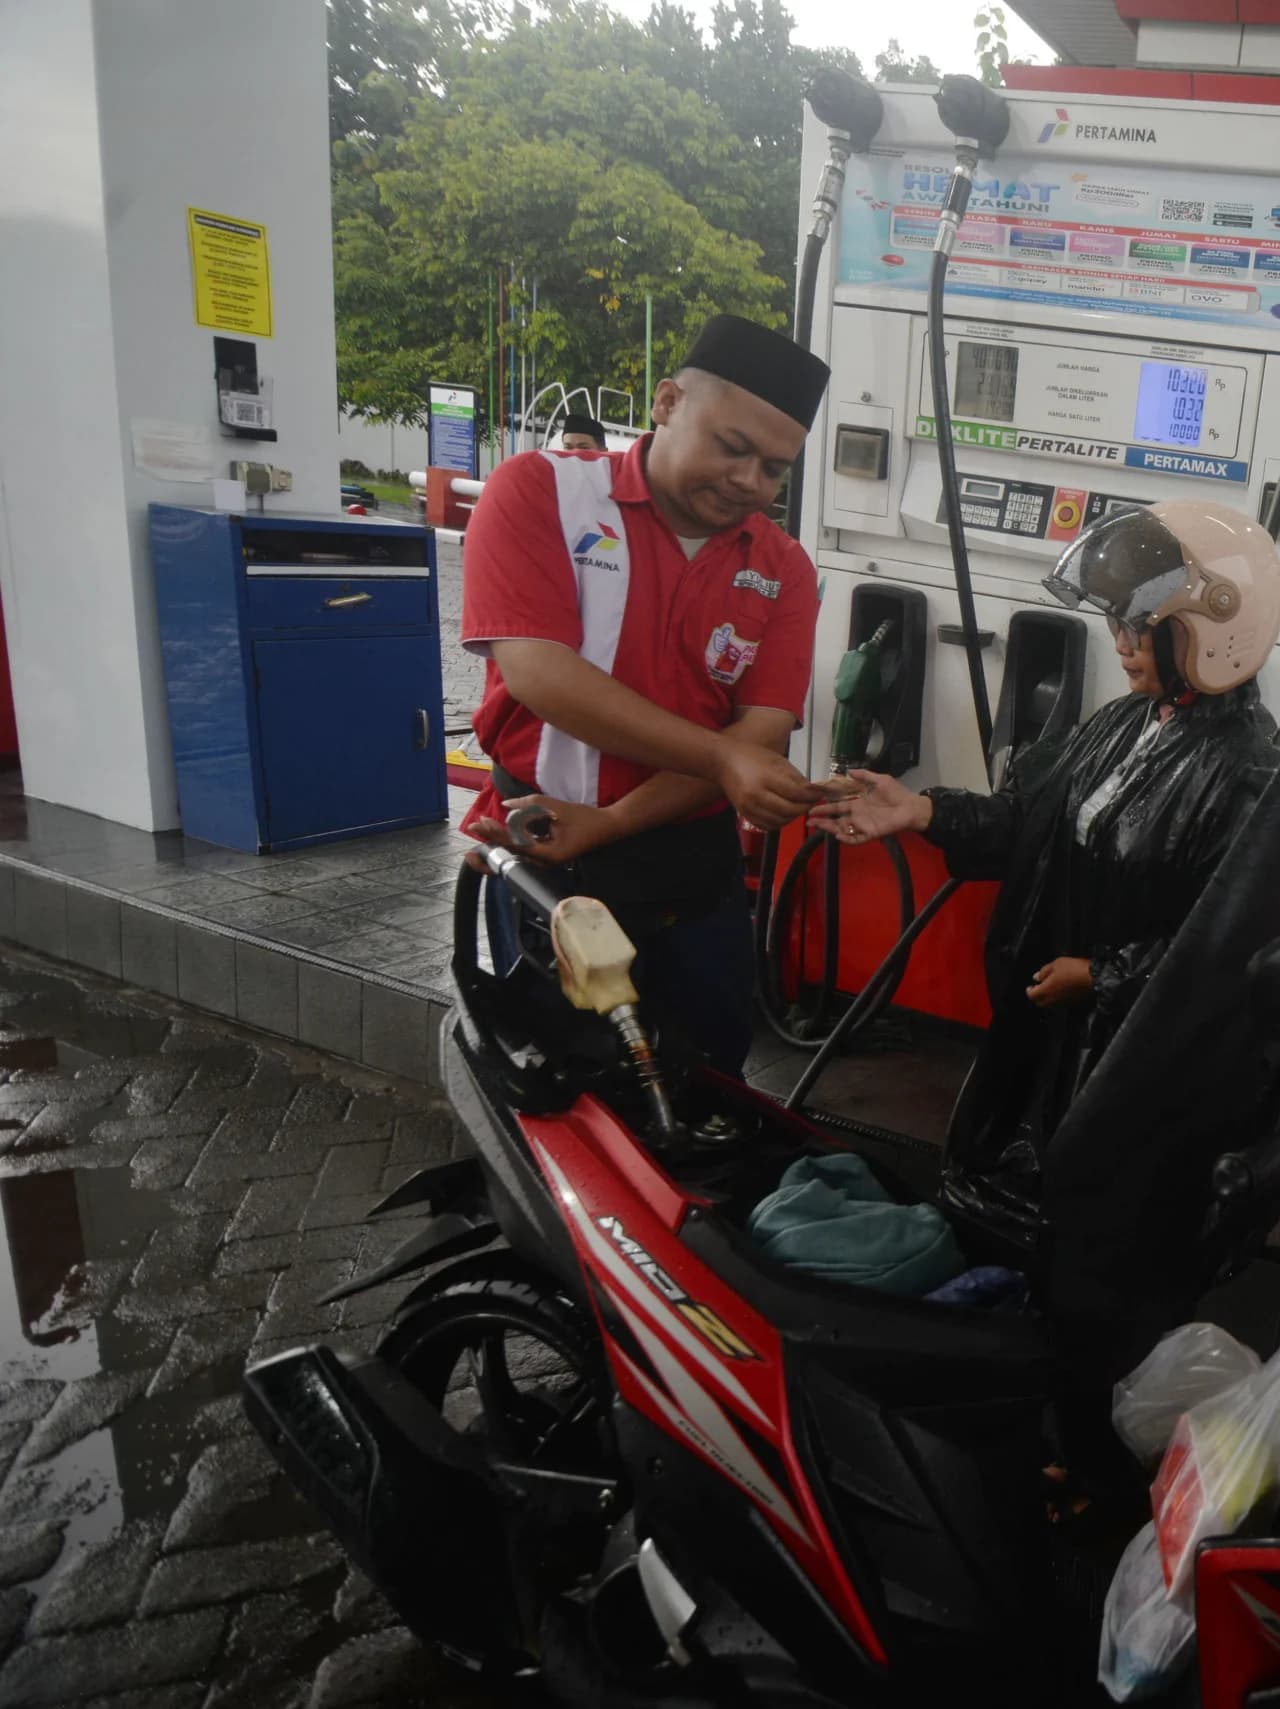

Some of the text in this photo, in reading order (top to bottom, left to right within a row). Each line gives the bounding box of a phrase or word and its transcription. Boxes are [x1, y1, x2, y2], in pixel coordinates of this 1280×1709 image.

[1075, 124, 1157, 144] PERTAMINA
[965, 215, 998, 223] ELASA
[1080, 225, 1115, 234] KAMIS
[1140, 231, 1178, 240] JUMAT
[1204, 236, 1240, 245] SABTU
[1191, 295, 1223, 304] OVO
[1215, 377, 1226, 391] Rp
[916, 420, 1016, 448] DXLITE
[1208, 428, 1220, 441] Rp
[1017, 435, 1120, 460] PERTALITE
[1143, 453, 1229, 477] PERTAMAX
[597, 1216, 689, 1301] MIO
